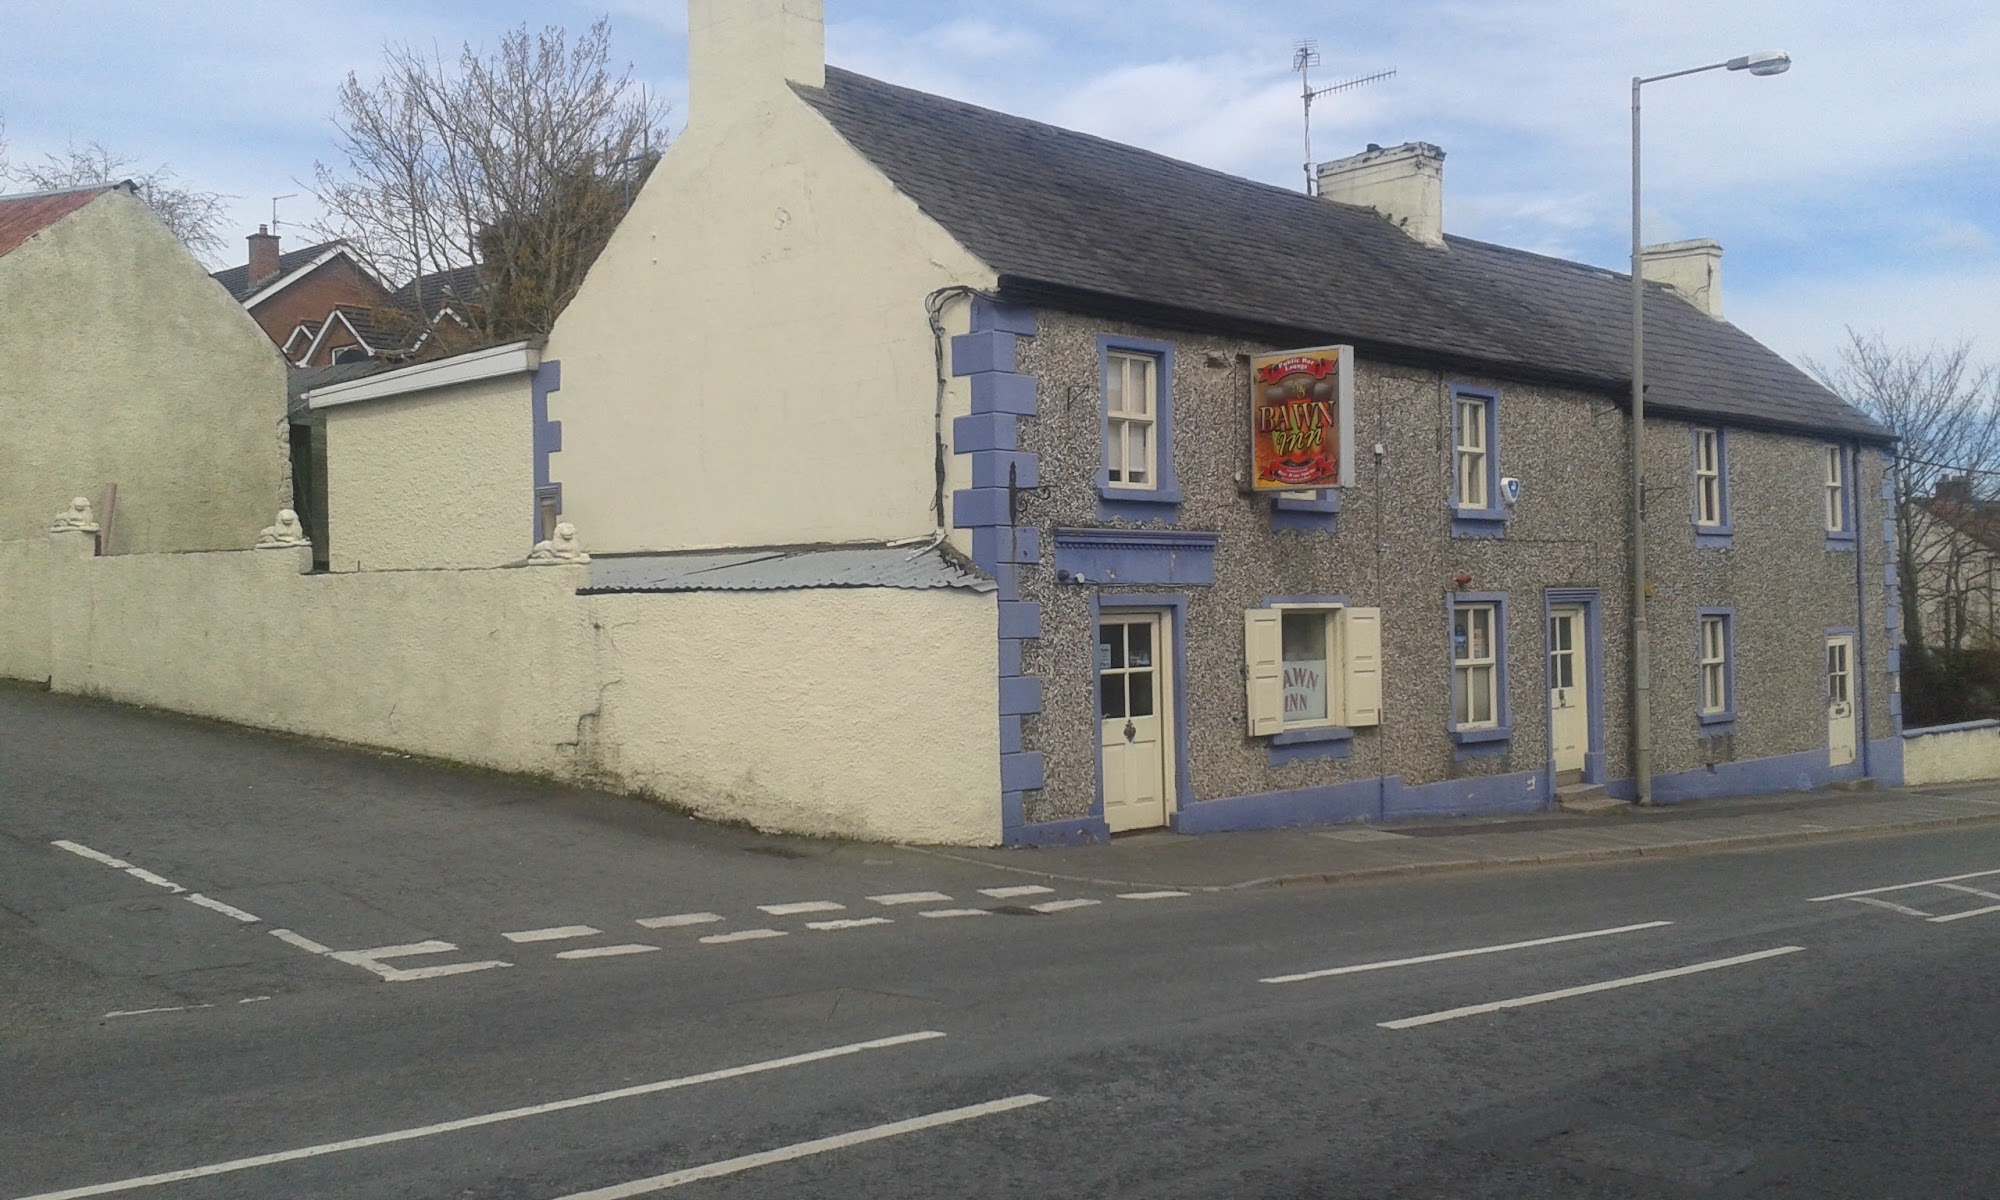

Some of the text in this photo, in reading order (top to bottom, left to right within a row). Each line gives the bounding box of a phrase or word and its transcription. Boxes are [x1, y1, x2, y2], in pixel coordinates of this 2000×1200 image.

[1260, 401, 1336, 432] BAWN
[1277, 428, 1322, 457] Inn
[1284, 693, 1308, 712] INN
